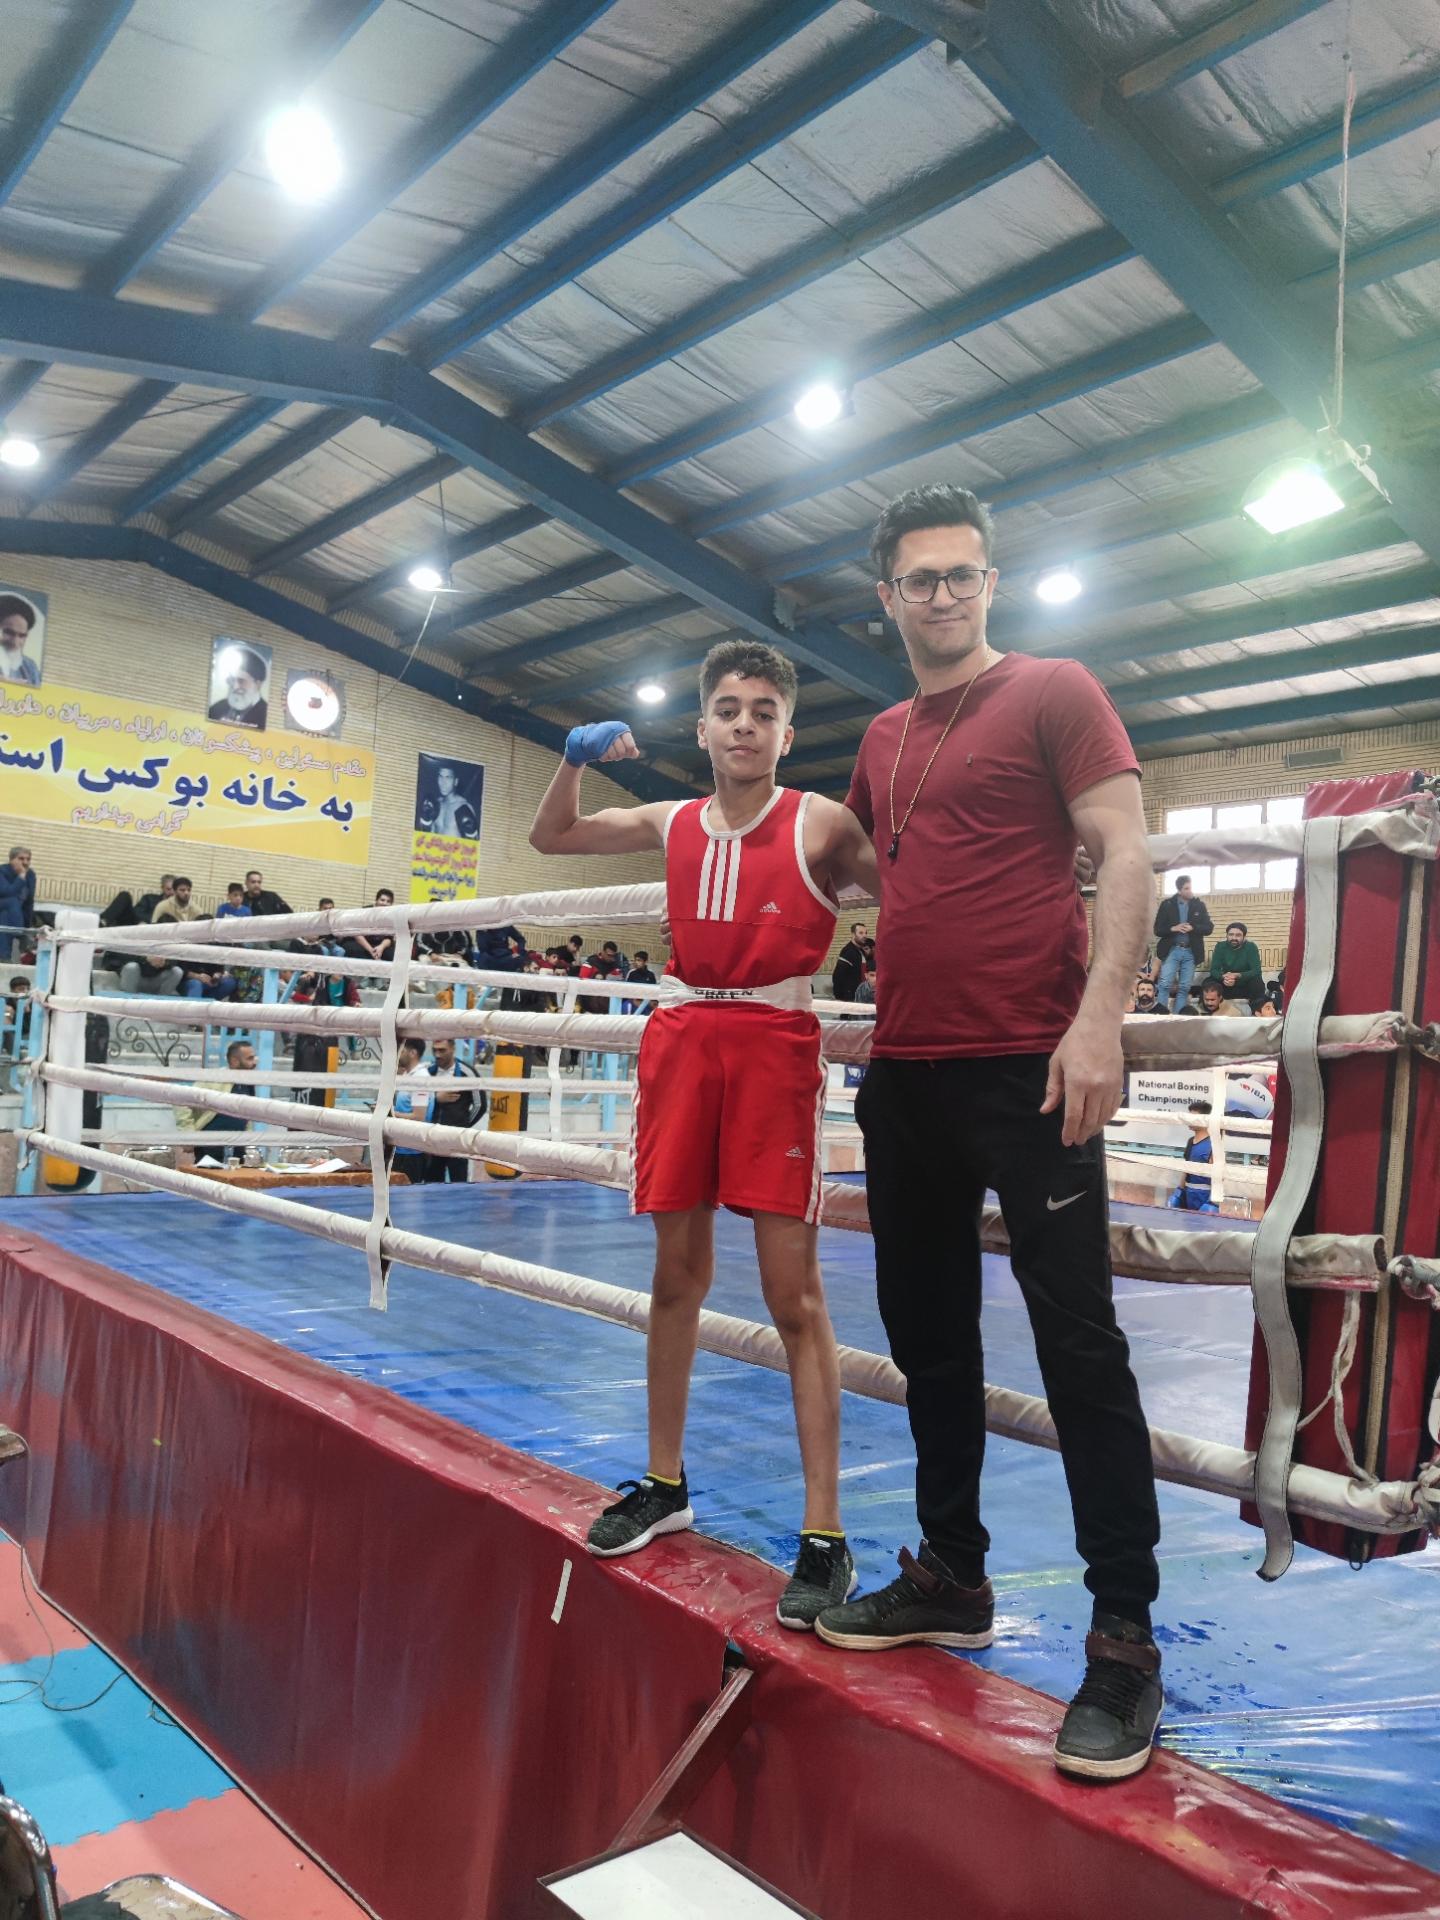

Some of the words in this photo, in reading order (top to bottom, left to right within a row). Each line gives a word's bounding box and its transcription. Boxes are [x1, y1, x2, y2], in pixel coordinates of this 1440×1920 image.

[222, 773, 307, 812] خانه
[319, 795, 354, 832] به
[1138, 1080, 1176, 1090] National
[1177, 1082, 1210, 1094] Boxing
